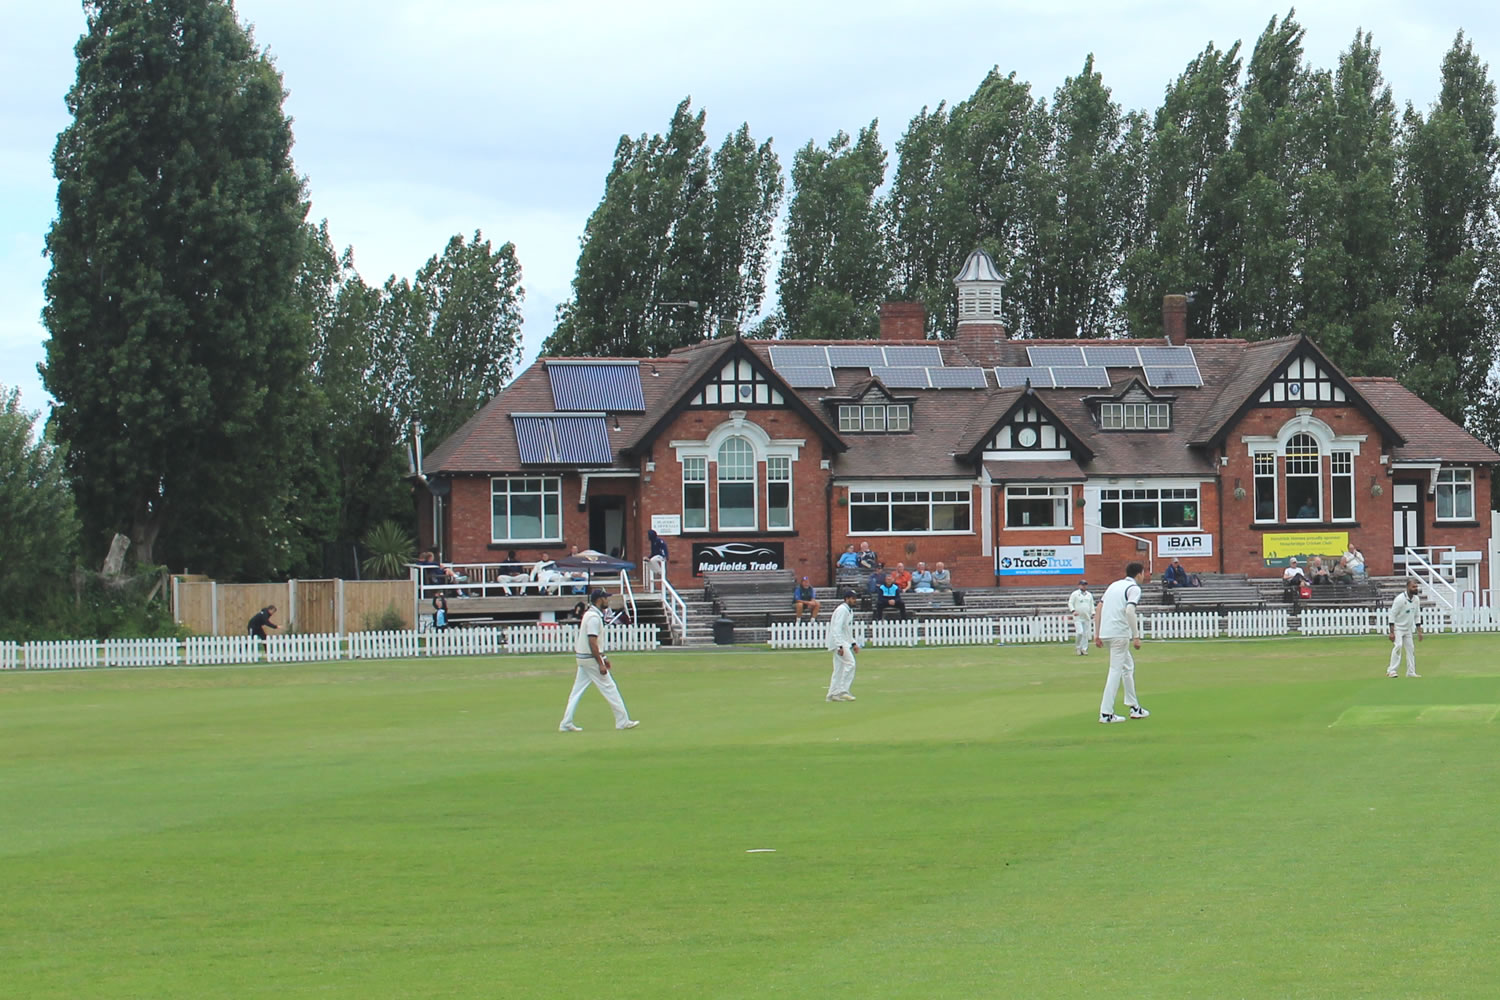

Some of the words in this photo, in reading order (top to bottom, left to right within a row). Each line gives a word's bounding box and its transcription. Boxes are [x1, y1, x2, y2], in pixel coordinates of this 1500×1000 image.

[1168, 537, 1202, 547] iBAR
[699, 562, 747, 571] Mayfields
[750, 561, 778, 570] Trade
[1013, 557, 1072, 568] TradeTrux
